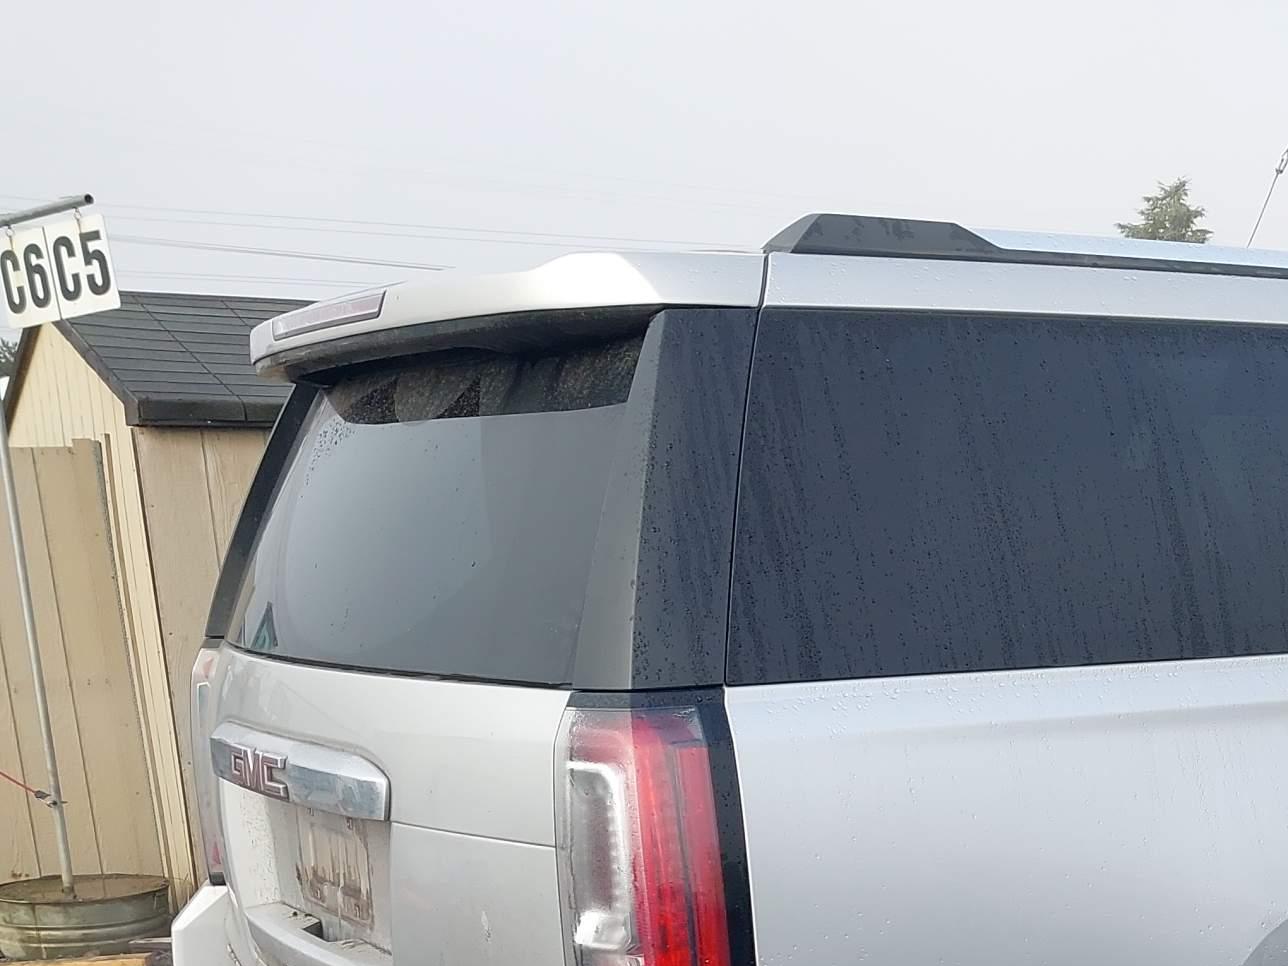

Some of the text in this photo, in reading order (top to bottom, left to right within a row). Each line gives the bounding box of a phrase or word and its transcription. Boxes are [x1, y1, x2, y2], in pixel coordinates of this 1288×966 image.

[0, 230, 112, 314] C6 C5
[230, 742, 290, 803] GMC
